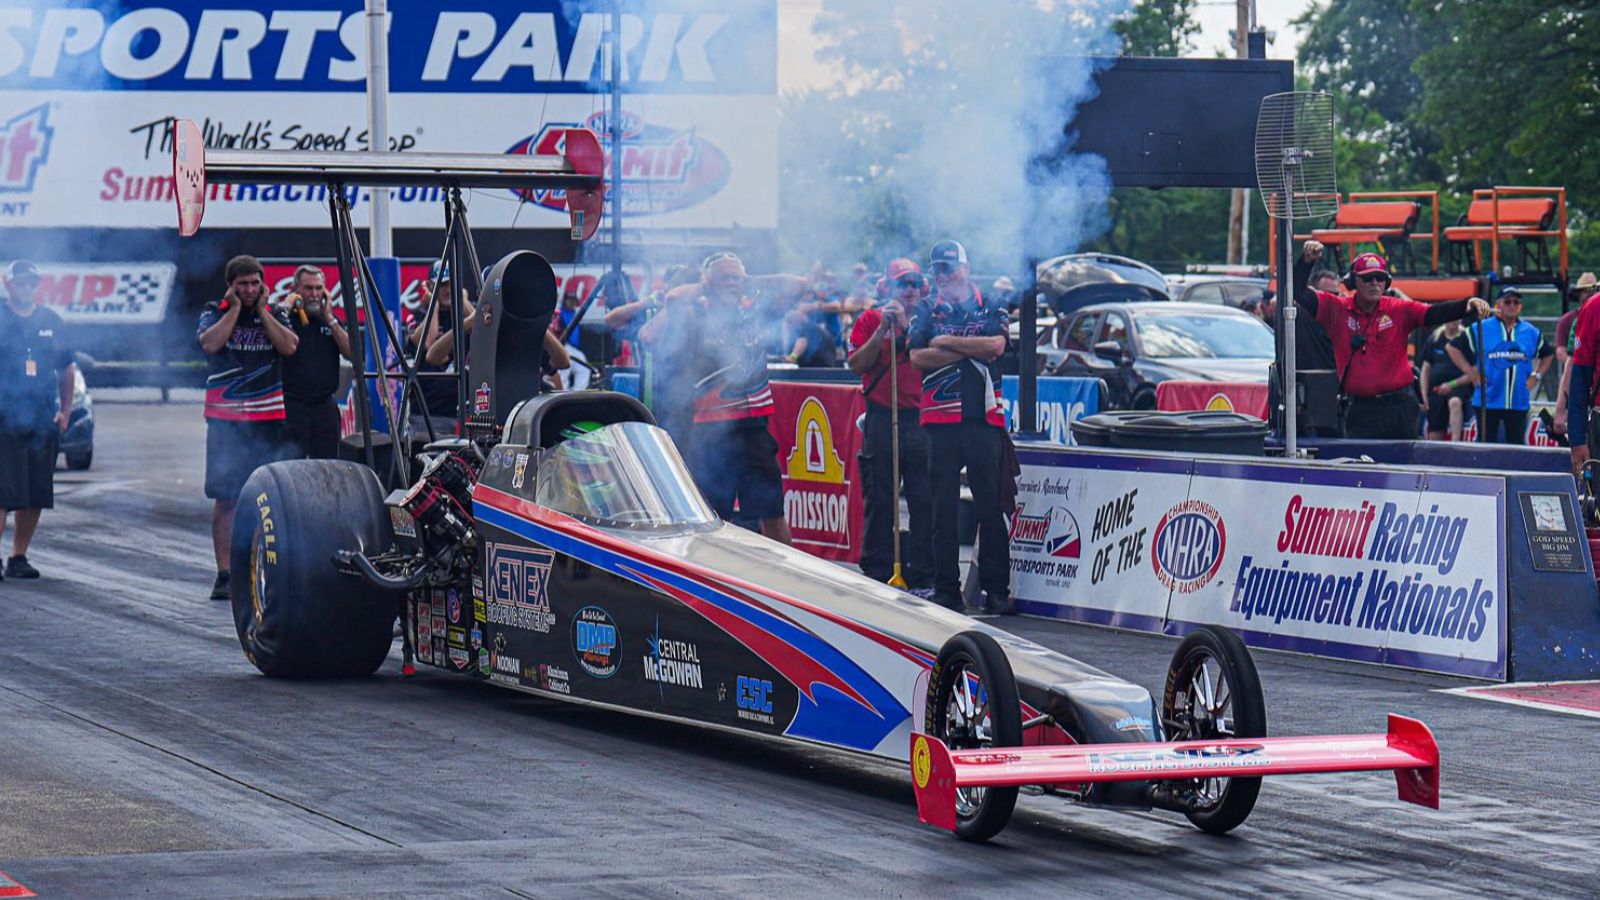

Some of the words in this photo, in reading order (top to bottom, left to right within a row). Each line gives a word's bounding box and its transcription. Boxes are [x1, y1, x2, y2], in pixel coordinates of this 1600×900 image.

[421, 11, 729, 82] PARK
[256, 492, 277, 566] EAGLE
[783, 489, 848, 535] MISSION
[1091, 488, 1138, 543] HOME
[1168, 500, 1219, 521] CHAMPIONSHIP
[1091, 543, 1114, 585] OF
[1117, 526, 1147, 574] THE
[1161, 516, 1216, 577] NHRA
[1277, 494, 1376, 560] Summit
[1368, 502, 1468, 576] Racing
[1009, 558, 1056, 577] OTORSPORTS
[1056, 563, 1080, 579] PARK
[1158, 569, 1176, 594] DRAG
[1177, 578, 1207, 595] RACING
[487, 602, 518, 626] ROOFING
[518, 607, 550, 633] SYSTEMS
[1230, 556, 1363, 627] Equipment
[1356, 568, 1493, 643] Nationals
[643, 656, 703, 689] McGOWAN
[658, 638, 700, 663] CENTRAL
[736, 675, 773, 713] ESC
